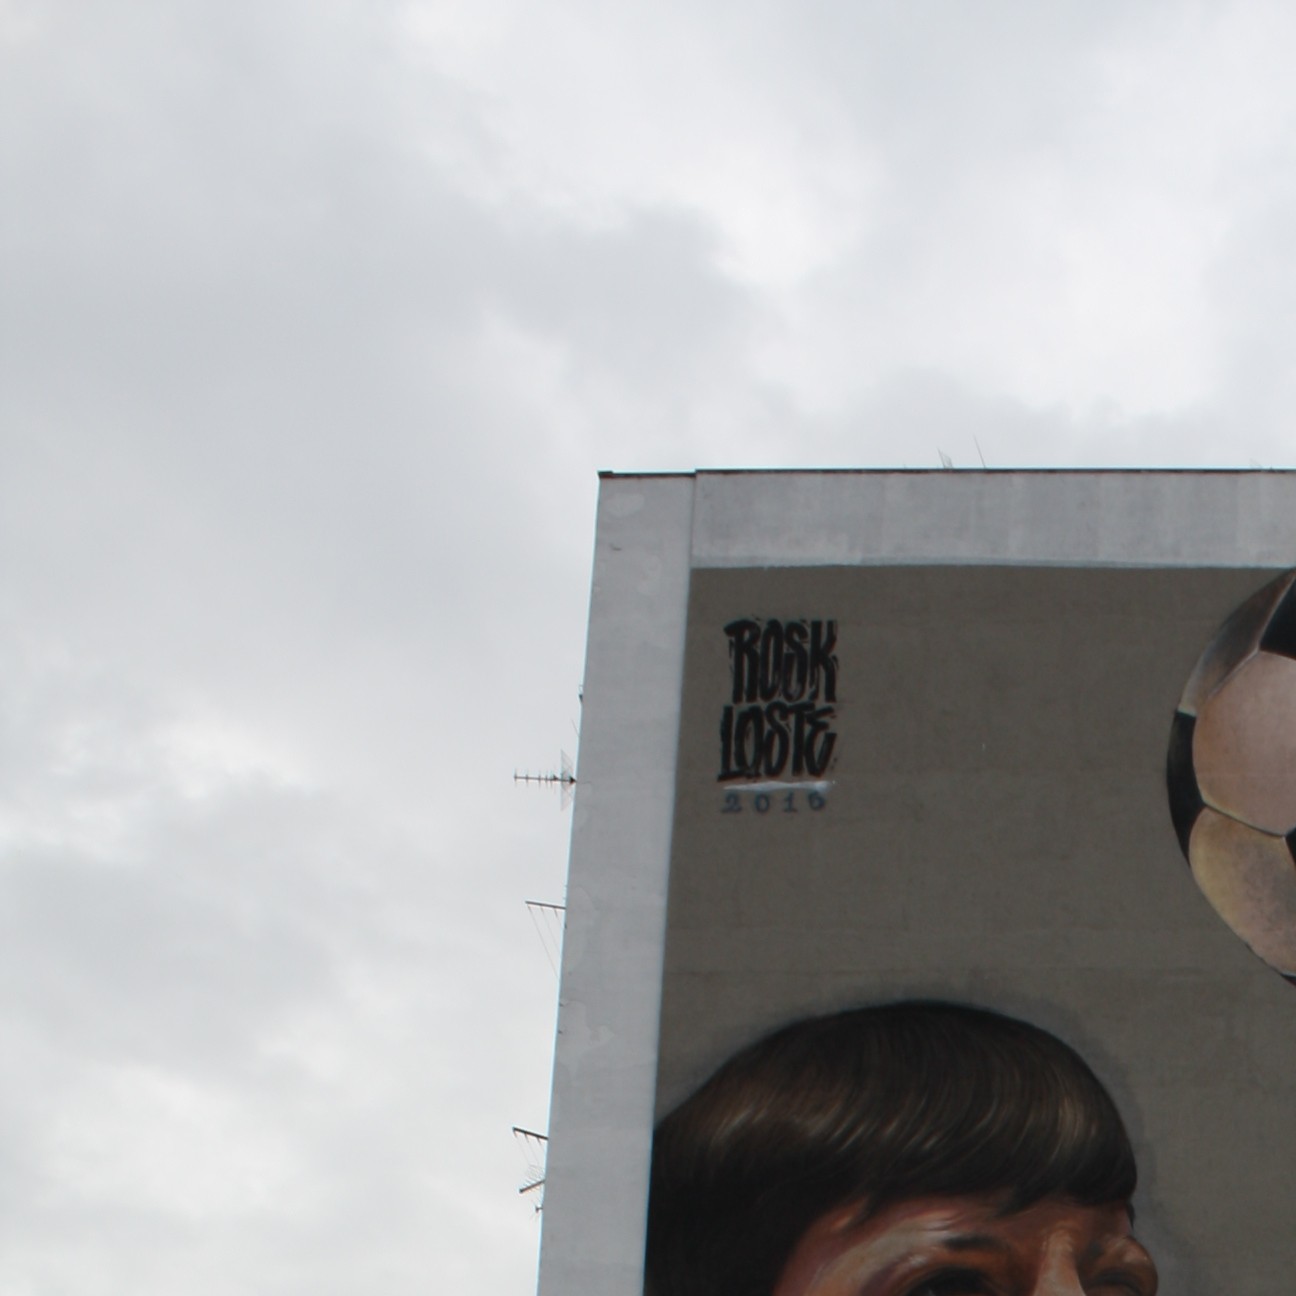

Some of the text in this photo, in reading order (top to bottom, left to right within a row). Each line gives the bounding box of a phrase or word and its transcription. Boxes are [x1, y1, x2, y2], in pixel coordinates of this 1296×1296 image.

[723, 618, 838, 703] ROSK
[717, 701, 837, 781] LOSTE
[720, 790, 826, 813] 2016
